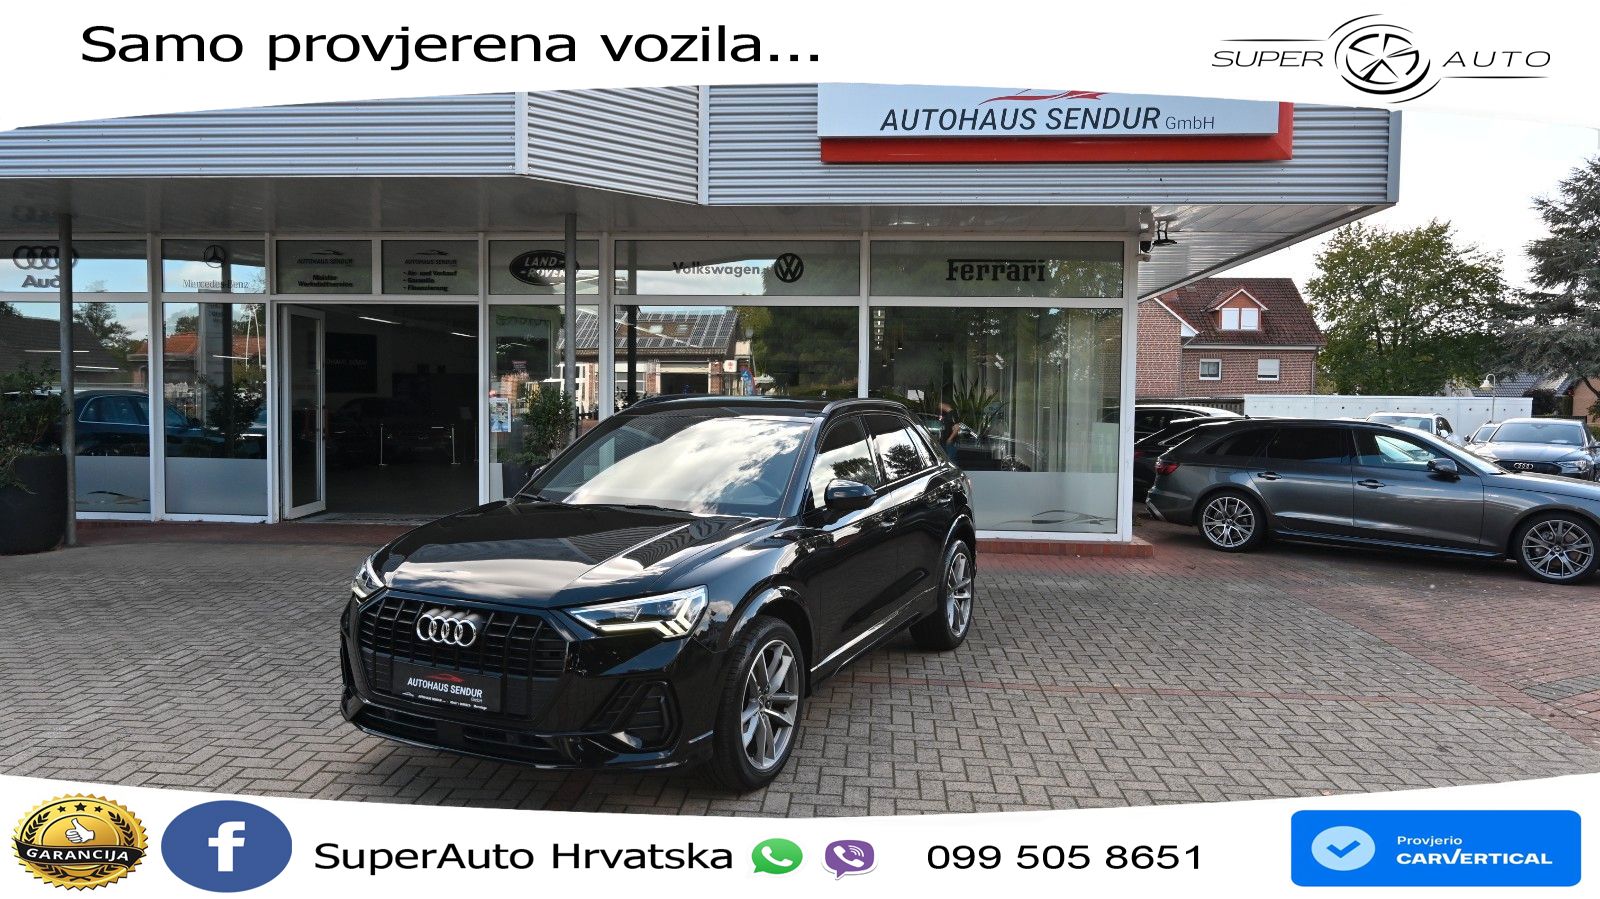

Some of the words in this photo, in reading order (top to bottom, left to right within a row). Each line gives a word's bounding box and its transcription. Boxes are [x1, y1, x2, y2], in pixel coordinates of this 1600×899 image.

[880, 107, 1037, 131] AUTOHAUS
[1045, 107, 1161, 130] SENDUR
[1165, 115, 1215, 130] GmbH
[672, 261, 760, 279] Volkswagen
[945, 258, 1045, 282] Ferrari
[22, 275, 61, 288] Aud
[407, 677, 449, 693] AUTOHAUS
[450, 684, 483, 699] SENDUR
